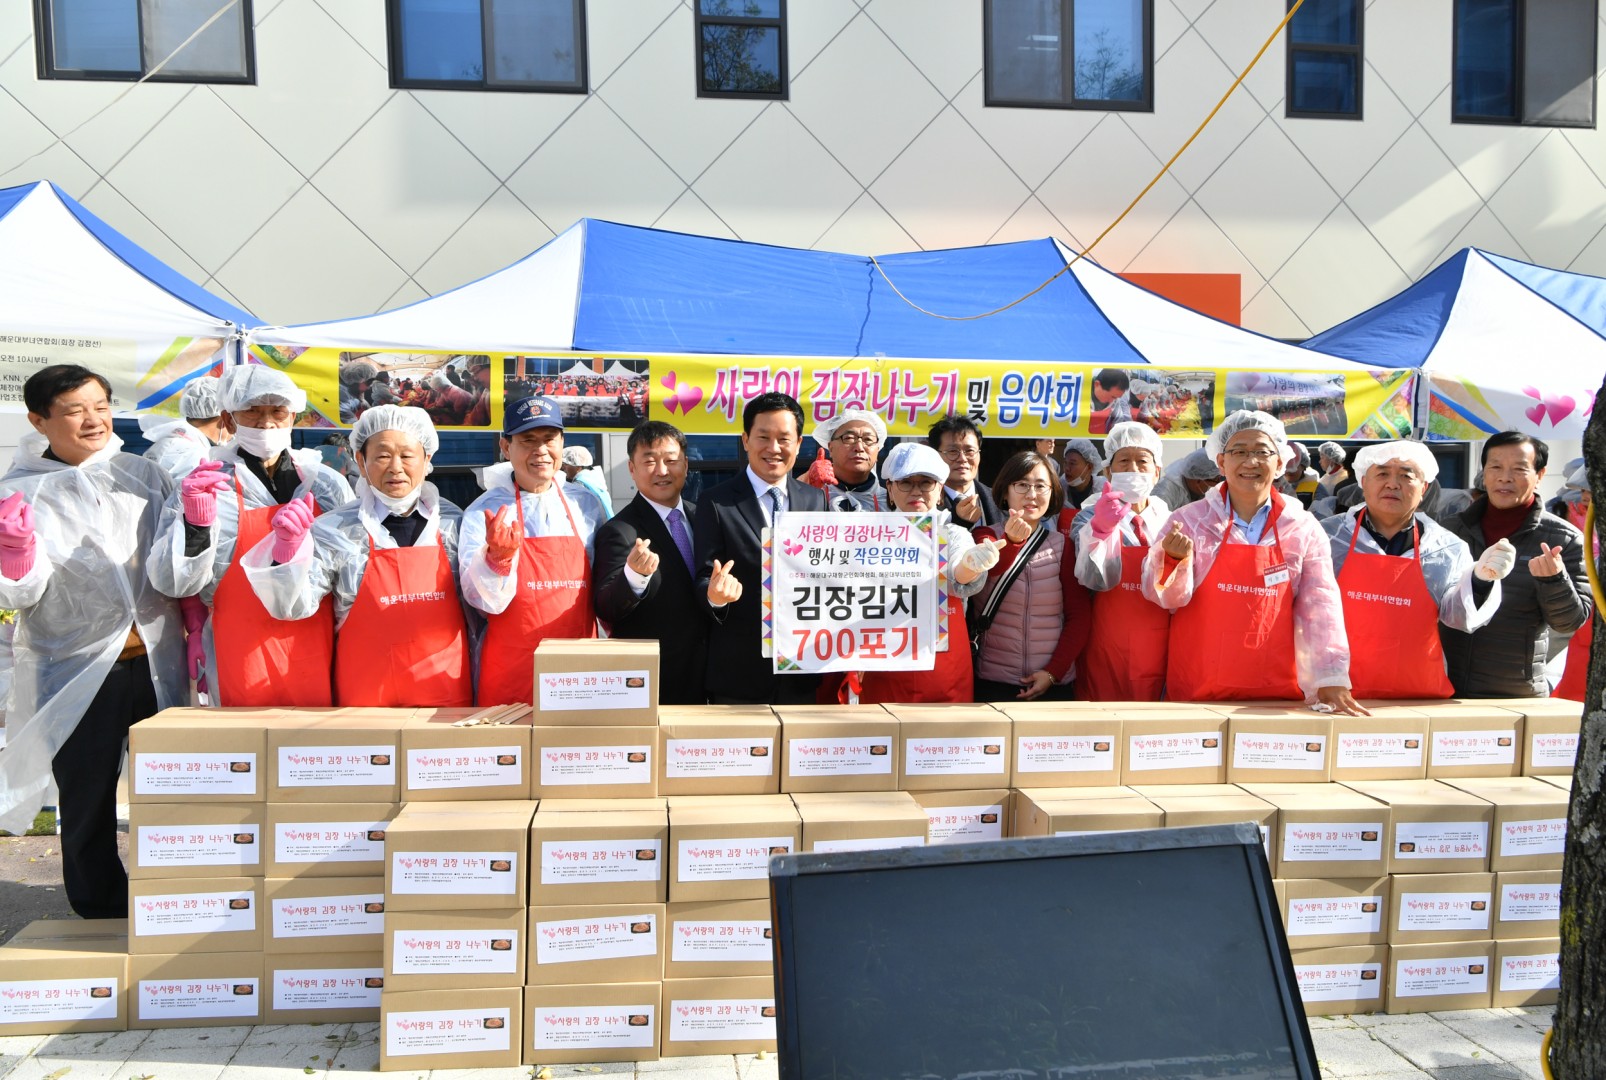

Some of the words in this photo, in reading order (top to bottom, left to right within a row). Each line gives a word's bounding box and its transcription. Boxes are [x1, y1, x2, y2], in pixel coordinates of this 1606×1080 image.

[810, 371, 958, 422] 김장나누기
[968, 380, 990, 422] 및
[998, 374, 1082, 424] 음악회
[798, 525, 838, 542] 사랑의
[844, 525, 910, 543] 김장나누기
[809, 547, 835, 565] 행사
[840, 550, 850, 565] 및
[854, 547, 920, 565] 작은음악회
[527, 580, 586, 590] 해운대부녀연합회
[1218, 583, 1278, 597] 해운대부녀연합회
[380, 591, 446, 605] 해운대부녀연합회
[792, 585, 918, 620] 김장김치
[1348, 591, 1411, 606] 해운대부녀연합회
[792, 627, 918, 661] 700포기
[558, 677, 579, 686] 사랑의
[583, 676, 598, 686] 김장
[600, 676, 623, 685] 나누기
[560, 751, 582, 761] 사랑의
[585, 751, 599, 761] 김장
[602, 751, 624, 760] 나누기
[686, 747, 708, 757] 사랑의
[710, 747, 725, 757] 김장
[728, 748, 749, 756] 나누기
[300, 755, 323, 764] 사랑의
[328, 755, 343, 764] 김장
[346, 755, 369, 763] 나누기
[429, 756, 451, 768] 사랑의
[455, 756, 471, 766] 김장
[473, 756, 496, 765] 나누기
[158, 762, 181, 772] 사랑의
[186, 762, 201, 772] 김장
[205, 762, 229, 771] 나누기
[161, 835, 184, 844] 사랑의
[189, 834, 205, 844] 김장
[209, 834, 232, 843] 나누기
[298, 832, 321, 841] 사랑의
[325, 831, 340, 841] 김장
[344, 832, 366, 840] 나누기
[564, 850, 588, 861] 사랑의
[592, 851, 608, 860] 김장
[612, 850, 635, 859] 나누기
[700, 849, 723, 860] 사랑의
[727, 848, 742, 858] 김장
[747, 848, 768, 856] 나누기
[414, 857, 438, 868] 사랑의
[442, 857, 458, 868] 김장
[462, 858, 486, 867] 나누기
[154, 900, 179, 910] 사랑의
[183, 899, 198, 908] 김장
[203, 898, 225, 907] 나누기
[294, 906, 318, 916] 사랑의
[321, 904, 337, 914] 김장
[339, 903, 364, 912] 나누기
[557, 925, 580, 937] 사랑의
[585, 923, 601, 934] 김장
[606, 921, 627, 931] 나누기
[693, 926, 715, 936] 사랑의
[720, 926, 734, 936] 김장
[738, 927, 760, 936] 나누기
[417, 940, 441, 950] 사랑의
[446, 939, 461, 950] 김장
[466, 940, 489, 948] 나누기
[158, 984, 182, 993] 사랑의
[188, 984, 202, 992] 김장
[296, 979, 318, 988] 사랑의
[323, 978, 337, 987] 김장
[342, 978, 364, 986] 나누기
[15, 990, 40, 1000] 사랑의
[46, 989, 62, 999] 김장
[64, 988, 89, 997] 나누기
[690, 1005, 712, 1016] 사랑의
[717, 1005, 732, 1016] 김장
[736, 1005, 758, 1015] 나누기
[410, 1020, 433, 1032] 사랑의
[438, 1019, 454, 1030] 김장
[460, 1019, 482, 1028] 나누기
[557, 1016, 580, 1026] 사랑의
[586, 1016, 600, 1025] 김장
[603, 1016, 628, 1024] 나누기
